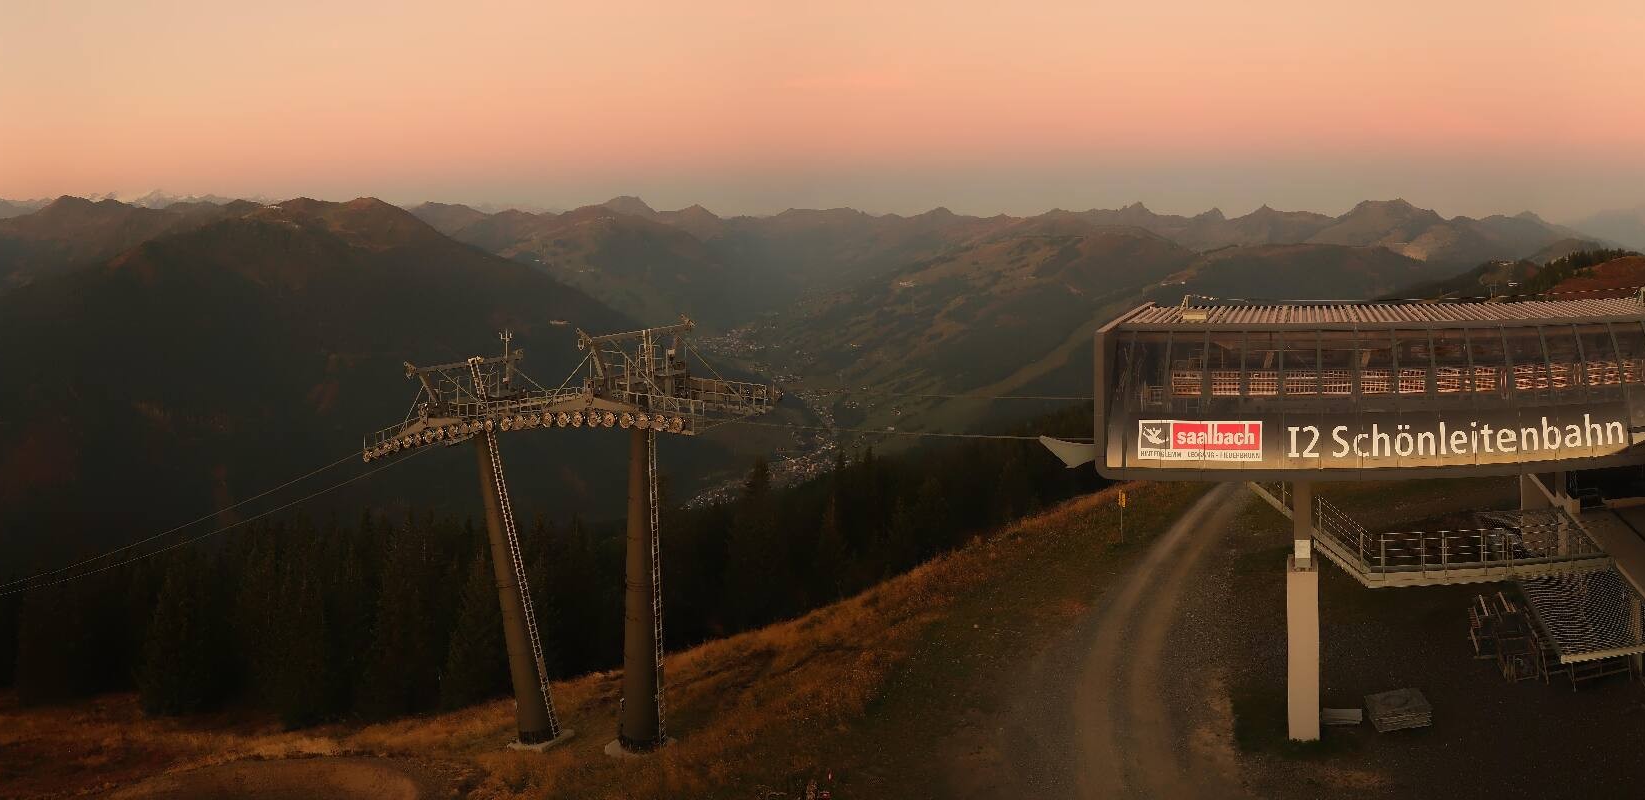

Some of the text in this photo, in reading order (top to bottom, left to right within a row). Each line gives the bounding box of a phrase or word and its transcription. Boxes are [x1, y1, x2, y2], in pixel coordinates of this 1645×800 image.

[1176, 423, 1255, 445] saalbach
[1287, 413, 1624, 458] I2 Schönleitenbahn
